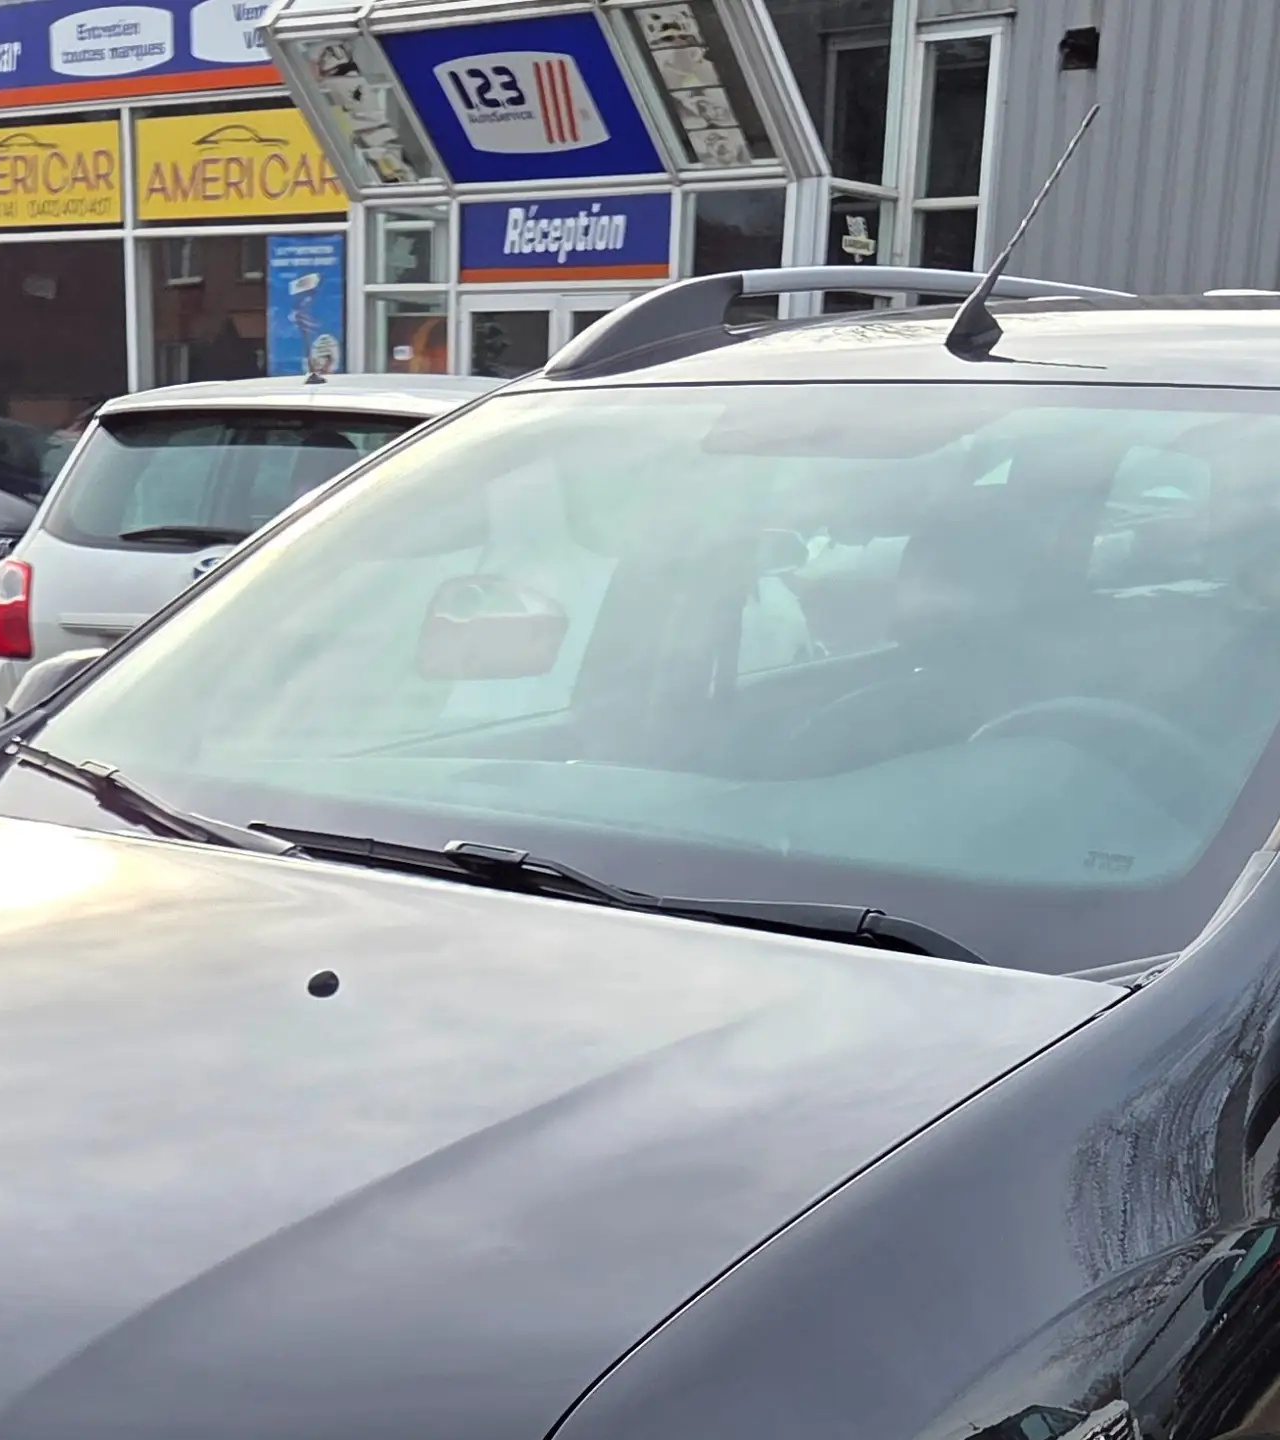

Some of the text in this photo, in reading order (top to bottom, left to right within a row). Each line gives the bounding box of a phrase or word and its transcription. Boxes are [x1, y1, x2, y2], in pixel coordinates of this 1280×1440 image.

[109, 42, 166, 61] marques
[145, 152, 344, 201] AMERICAR
[504, 202, 627, 264] Réception
